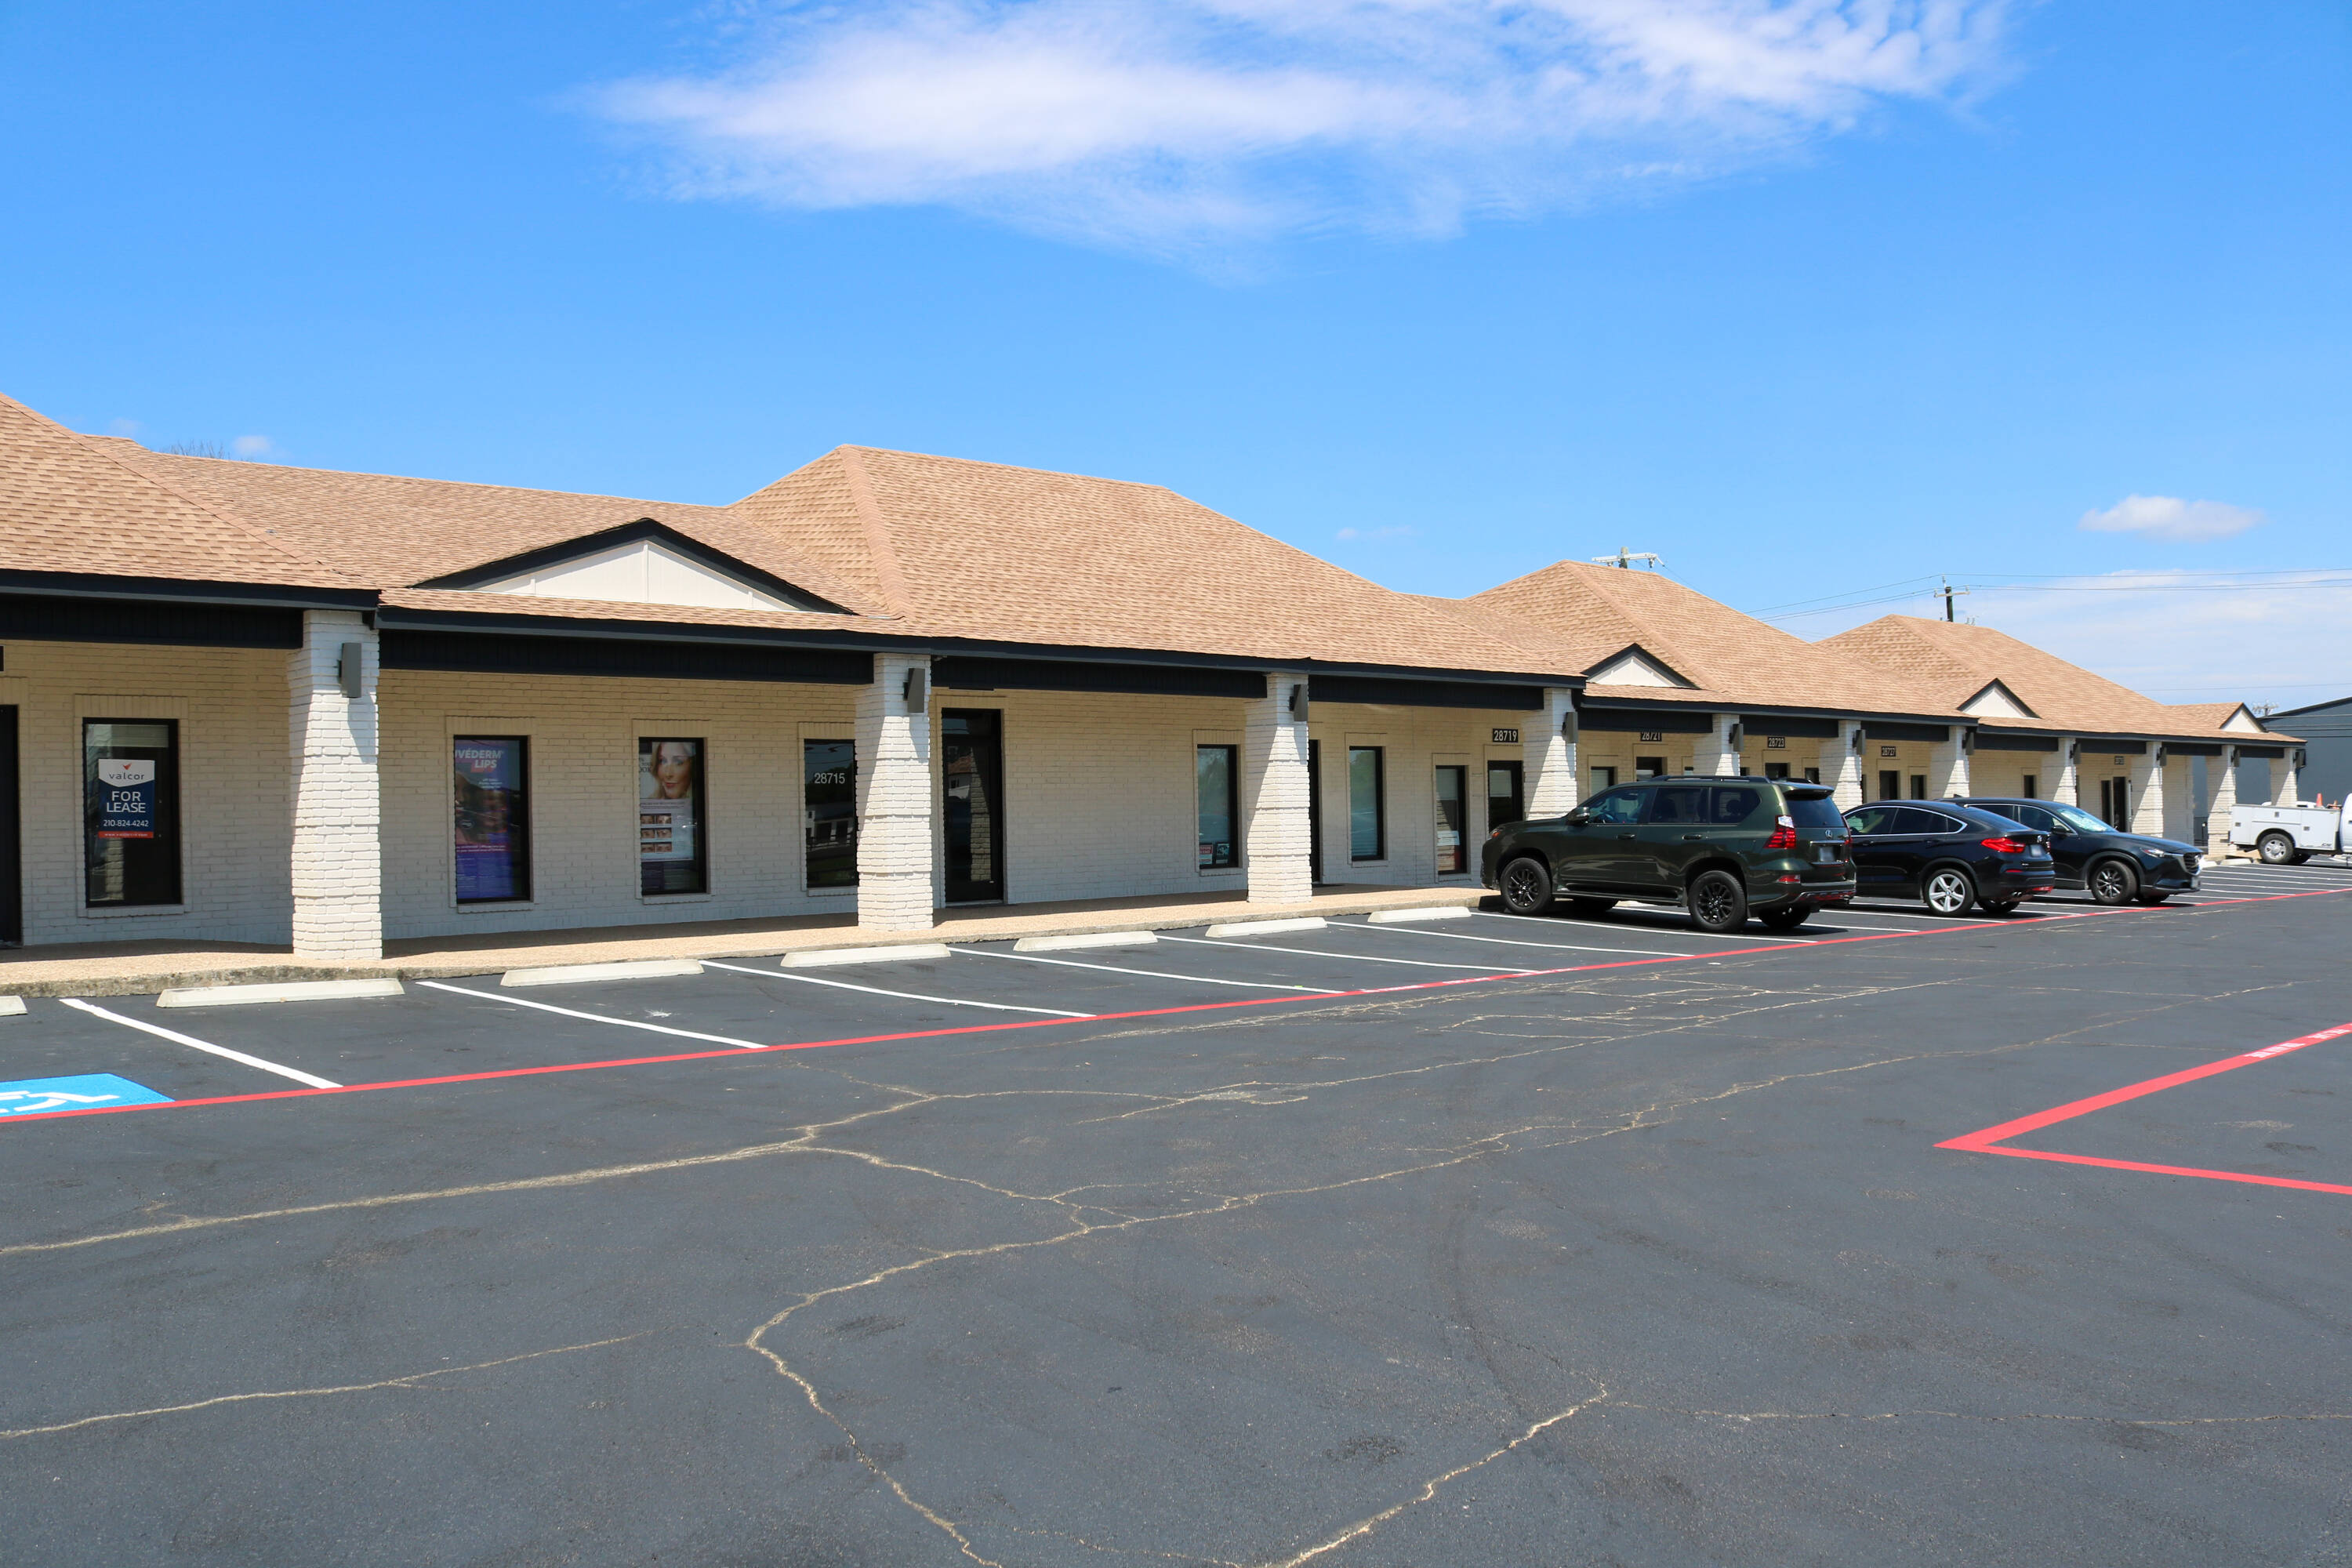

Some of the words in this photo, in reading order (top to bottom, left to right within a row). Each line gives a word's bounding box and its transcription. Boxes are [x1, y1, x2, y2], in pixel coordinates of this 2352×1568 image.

[1494, 730, 1517, 742] 28719
[474, 759, 498, 768] LIPS
[108, 771, 145, 780] valcor
[814, 772, 846, 785] 28715
[111, 790, 141, 802] FOR
[106, 802, 147, 813] LEASE
